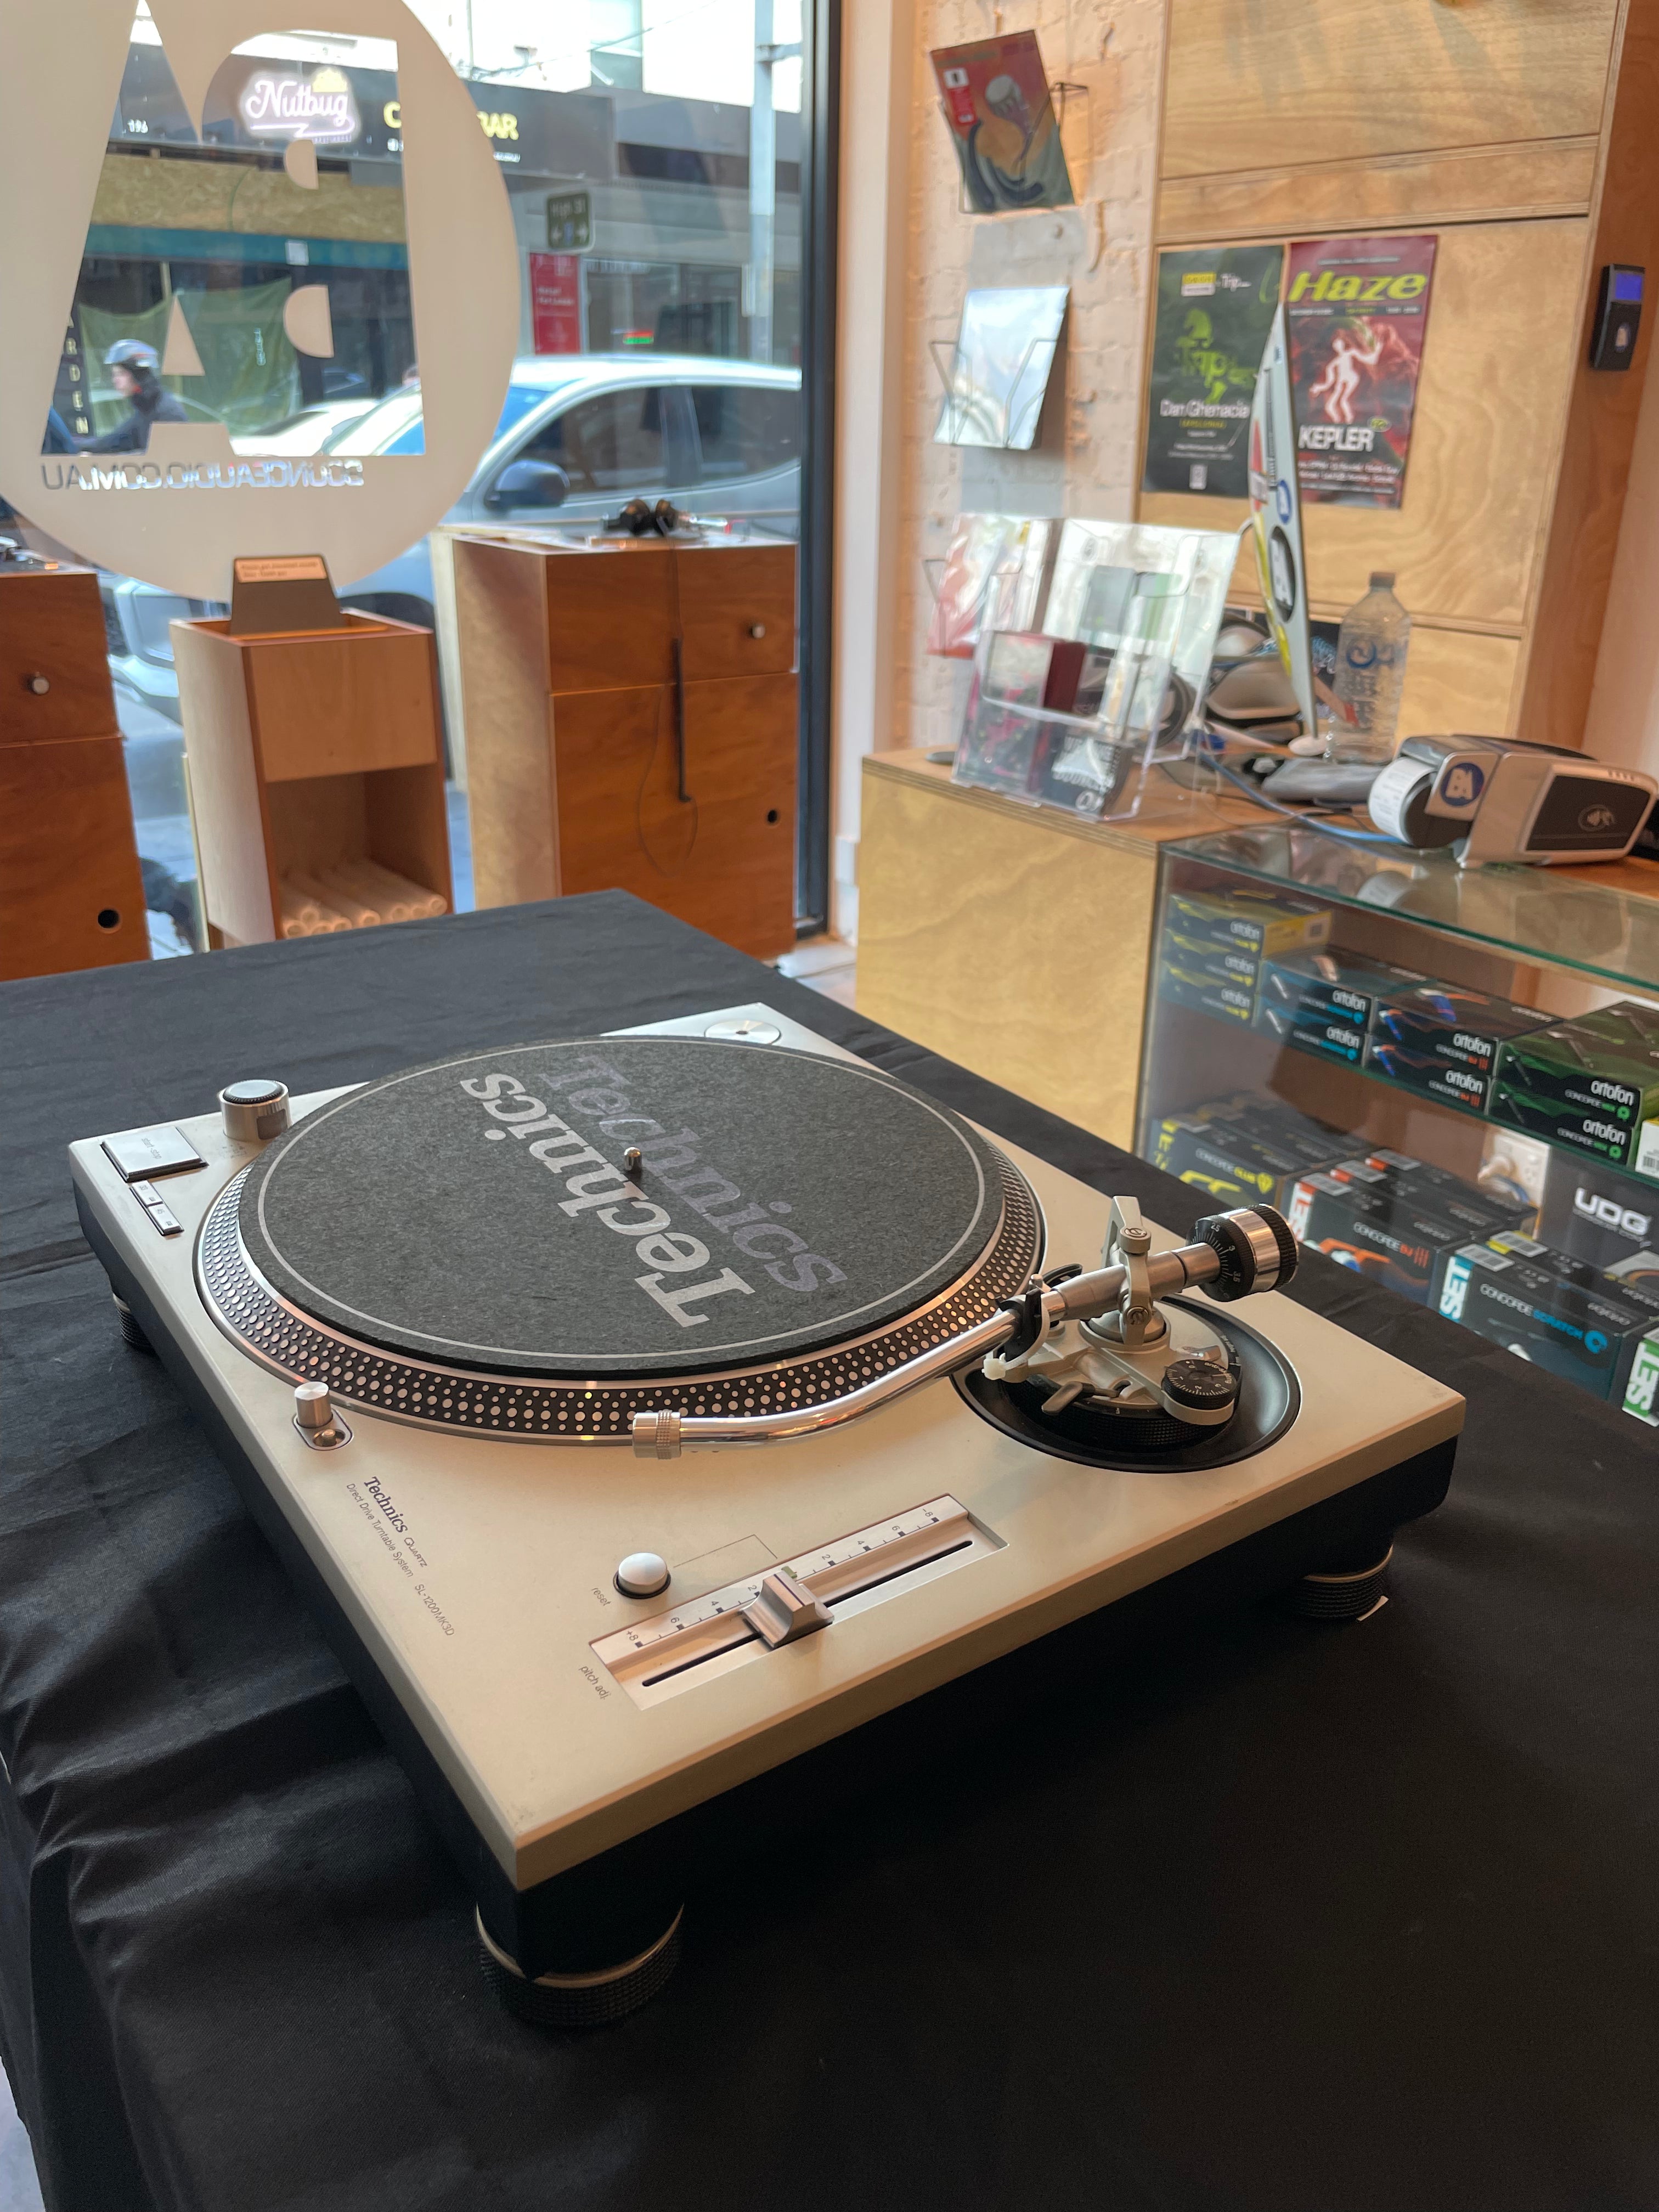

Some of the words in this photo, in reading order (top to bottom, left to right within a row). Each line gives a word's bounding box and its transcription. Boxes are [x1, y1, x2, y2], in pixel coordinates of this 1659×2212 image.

[245, 80, 349, 127] Nutbug
[1288, 270, 1427, 302] Haze
[1298, 424, 1375, 453] KEPLER
[1333, 990, 1366, 1012] ortofon
[1326, 1026, 1361, 1049] ortofon
[1453, 1033, 1492, 1057] ortofon
[1445, 1070, 1483, 1094] ortofon
[1591, 1080, 1635, 1106] ortofon
[1583, 1119, 1627, 1146] ortofon
[538, 1054, 848, 1293] Technics
[460, 1073, 756, 1328] Technics
[1575, 1187, 1650, 1236] UDG
[1439, 1256, 1472, 1320] SET
[1480, 1283, 1534, 1317] CONCORDE
[1625, 1341, 1659, 1411] SET
[364, 1476, 408, 1533] Technics
[346, 1483, 364, 1503] Direct
[359, 1503, 375, 1520] Drive
[372, 1519, 396, 1551] Turntable
[393, 1551, 414, 1578] System
[415, 1583, 455, 1637] SL-1200MK3D
[590, 1587, 611, 1607] reset
[626, 1630, 639, 1641] +8
[578, 1664, 601, 1685] pitch
